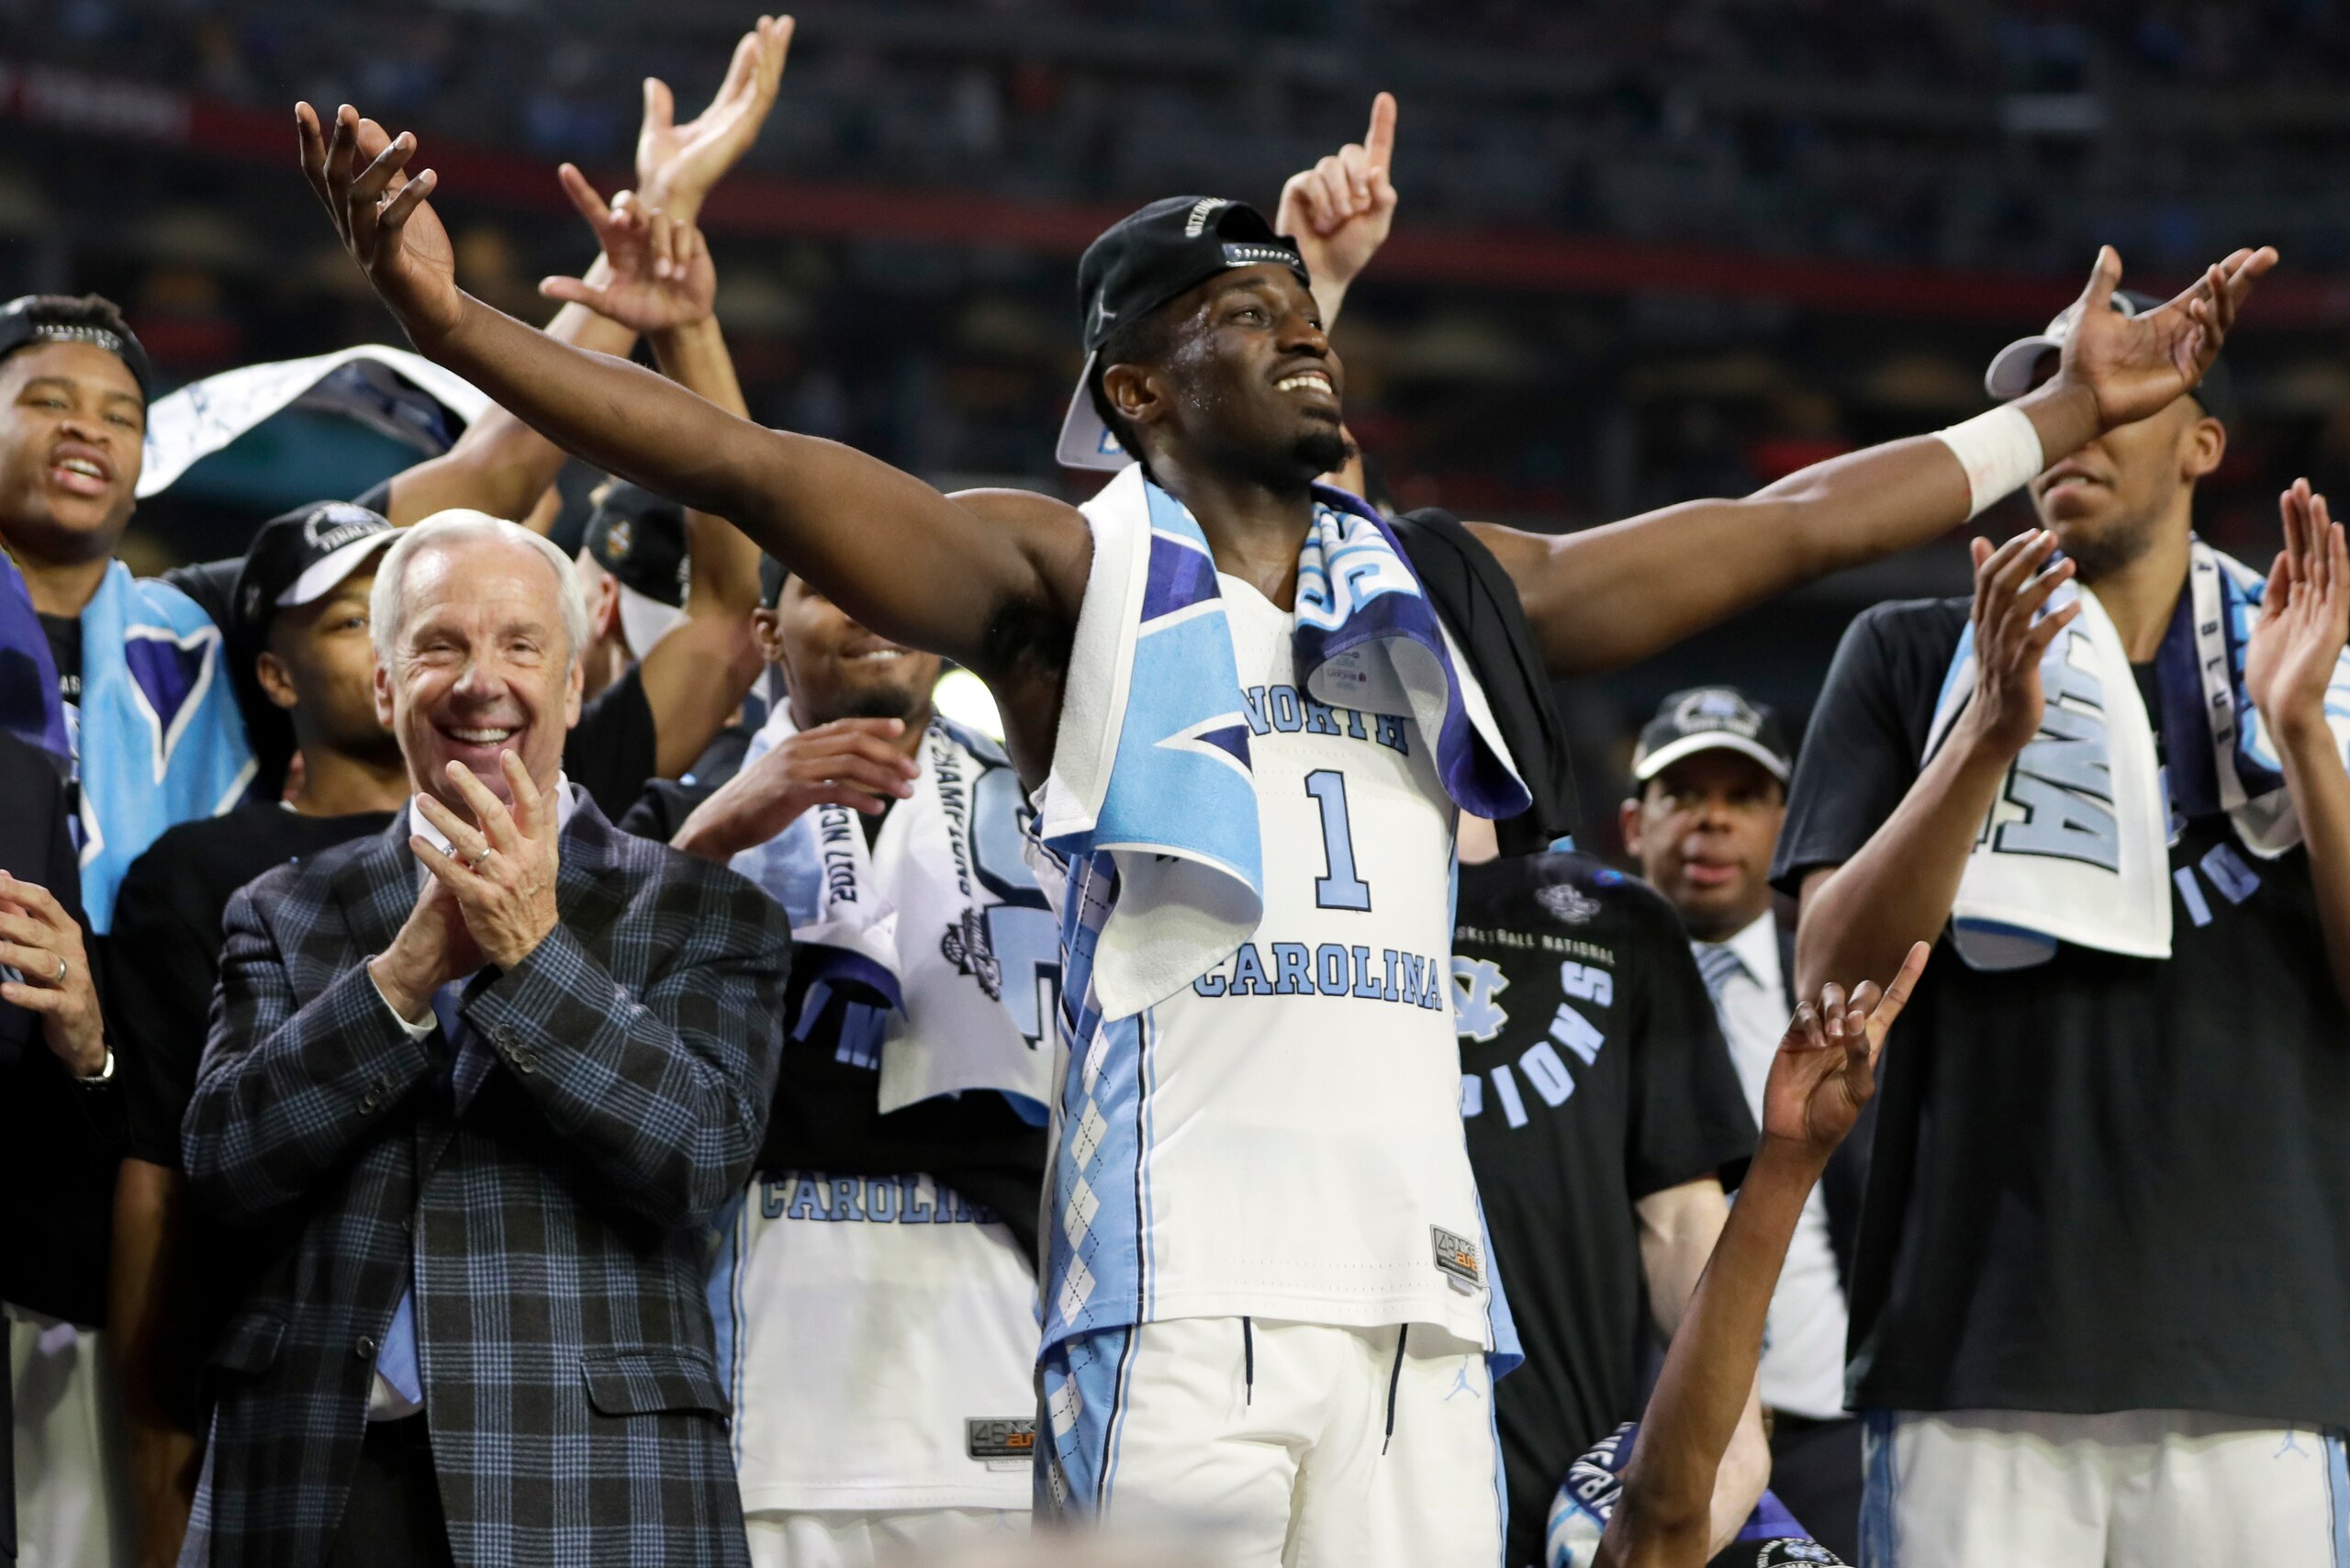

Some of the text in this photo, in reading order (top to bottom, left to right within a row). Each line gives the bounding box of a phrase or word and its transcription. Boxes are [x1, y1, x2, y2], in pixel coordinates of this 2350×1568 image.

[1304, 769, 1371, 913] 1
[1454, 925, 1536, 949] SKEBALL
[1193, 943, 1443, 1012] CAROLINA
[759, 1171, 998, 1225] CAROLI
